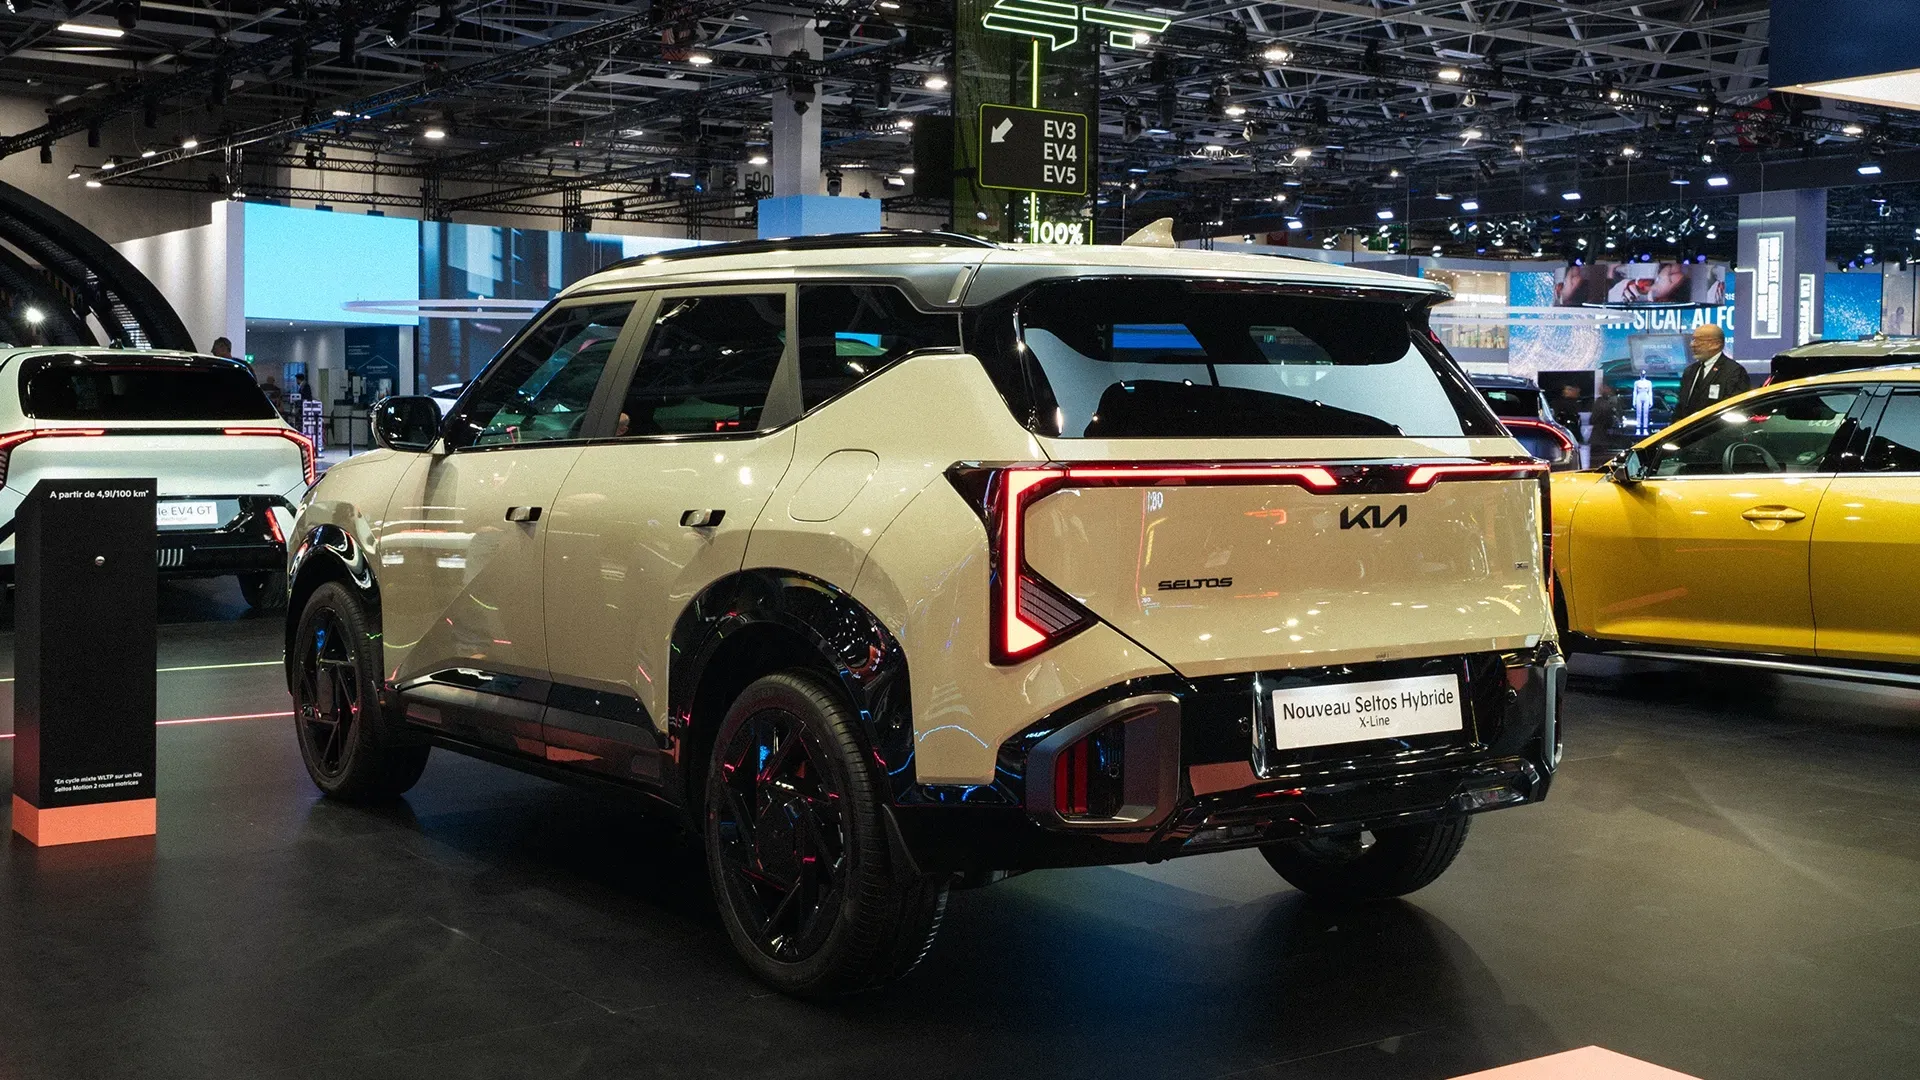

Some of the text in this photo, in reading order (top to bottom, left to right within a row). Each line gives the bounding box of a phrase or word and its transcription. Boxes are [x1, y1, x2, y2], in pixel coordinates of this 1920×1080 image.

[1043, 119, 1076, 140] EV3
[1043, 142, 1077, 162] EV4
[1043, 164, 1076, 185] EV5
[1031, 220, 1084, 245] 100%
[58, 490, 83, 500] partir
[84, 490, 95, 498] de
[171, 506, 193, 516] EV4
[196, 505, 212, 515] GT
[1340, 504, 1407, 530] KIA
[1158, 577, 1233, 590] SELTOS
[1283, 688, 1454, 720] Nouveau Seltos Hybride
[1359, 715, 1390, 729] X-Line
[65, 777, 80, 785] cycle
